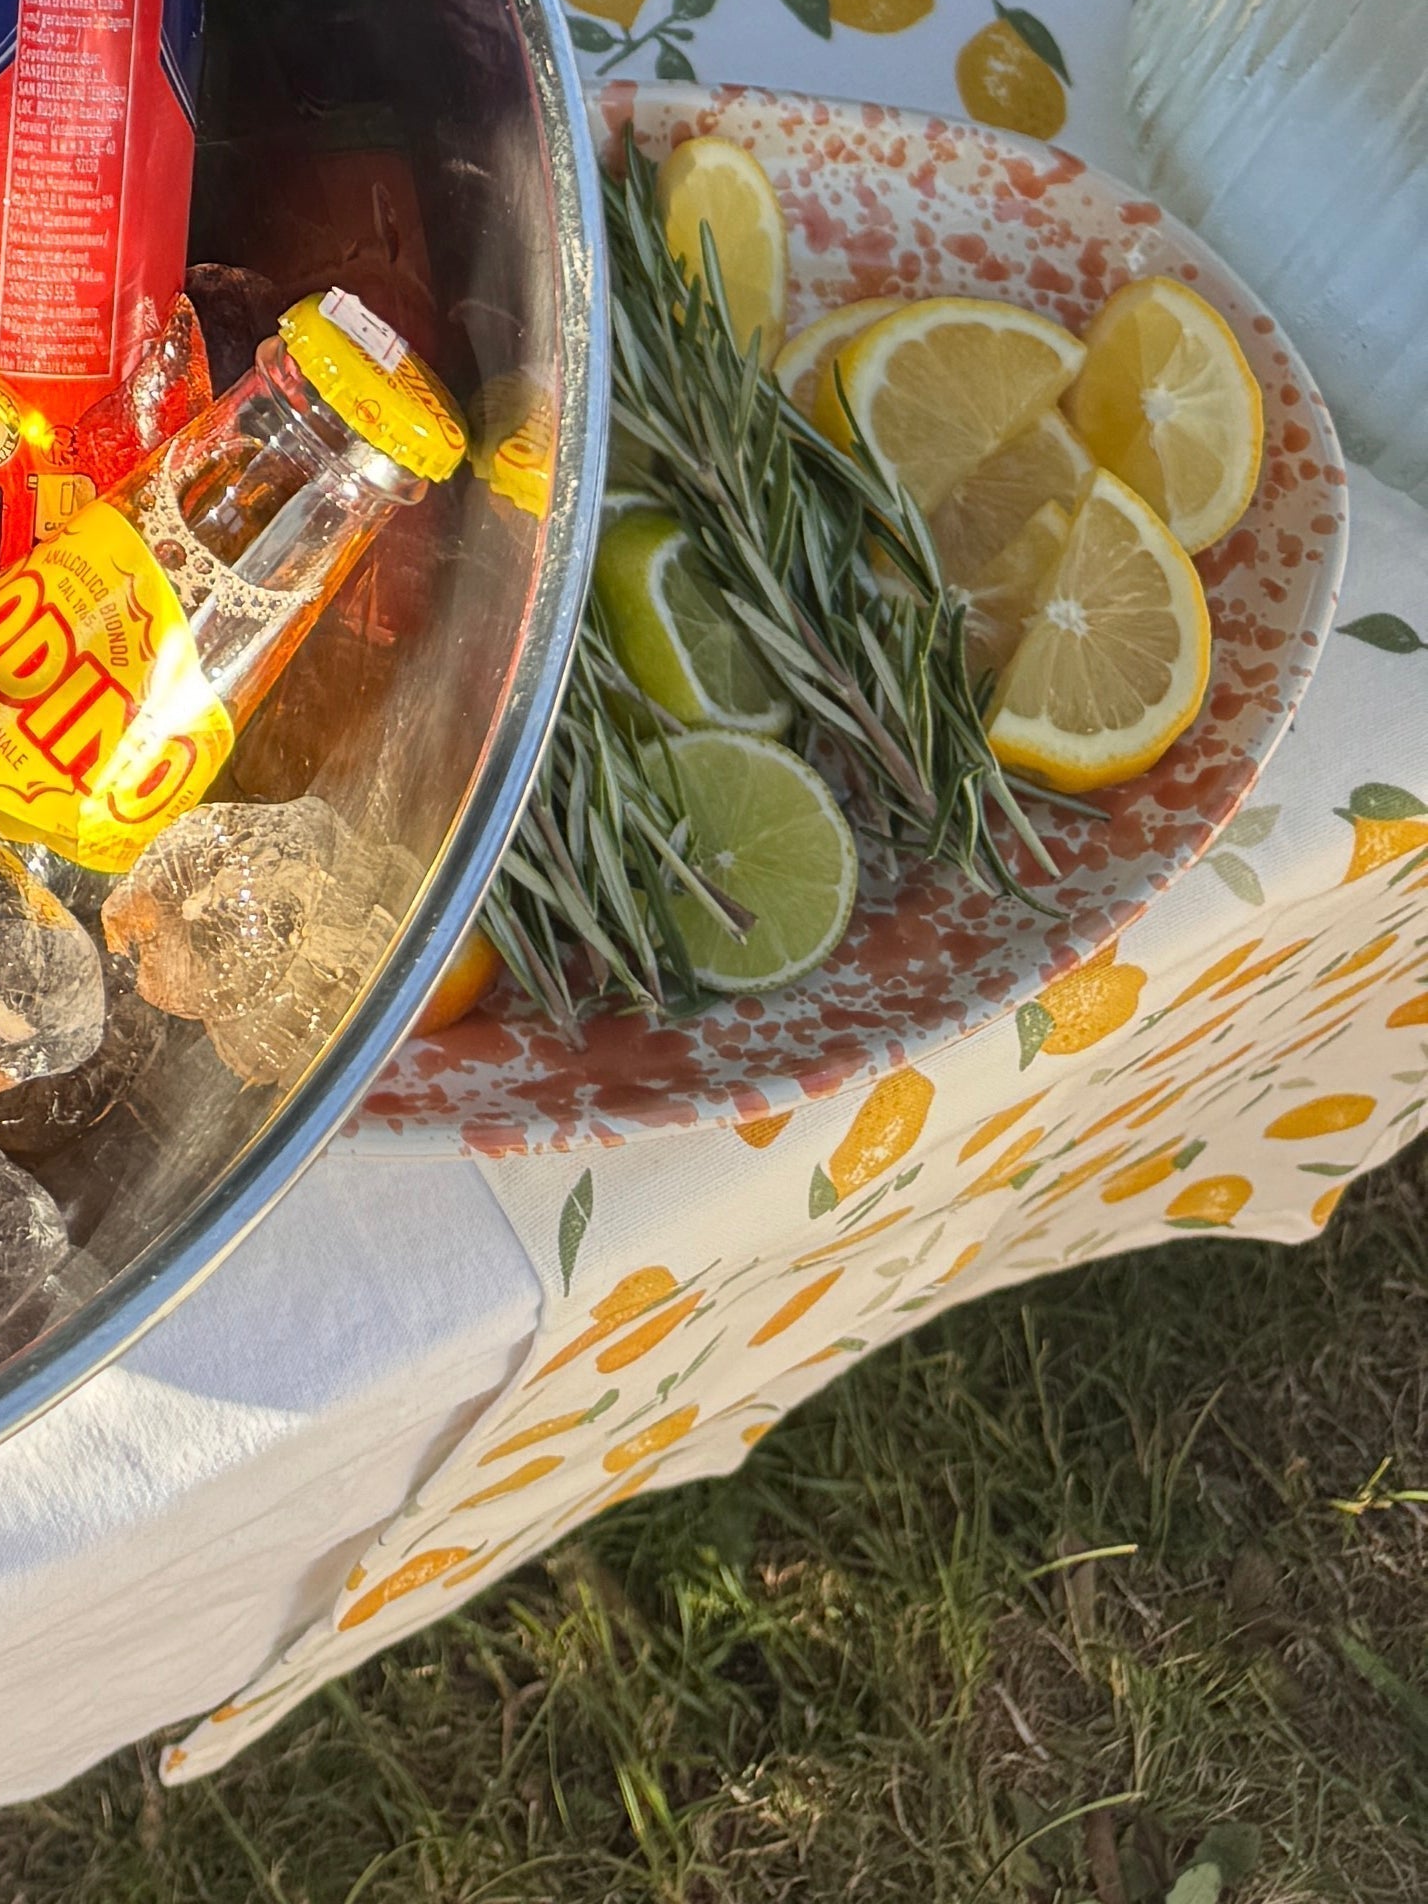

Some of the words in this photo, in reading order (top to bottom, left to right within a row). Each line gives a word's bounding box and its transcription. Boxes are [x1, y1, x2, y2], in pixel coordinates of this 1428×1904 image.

[41, 549, 110, 604] ANALCOLICO
[98, 601, 129, 668] BIONDO
[55, 576, 75, 601] DAL
